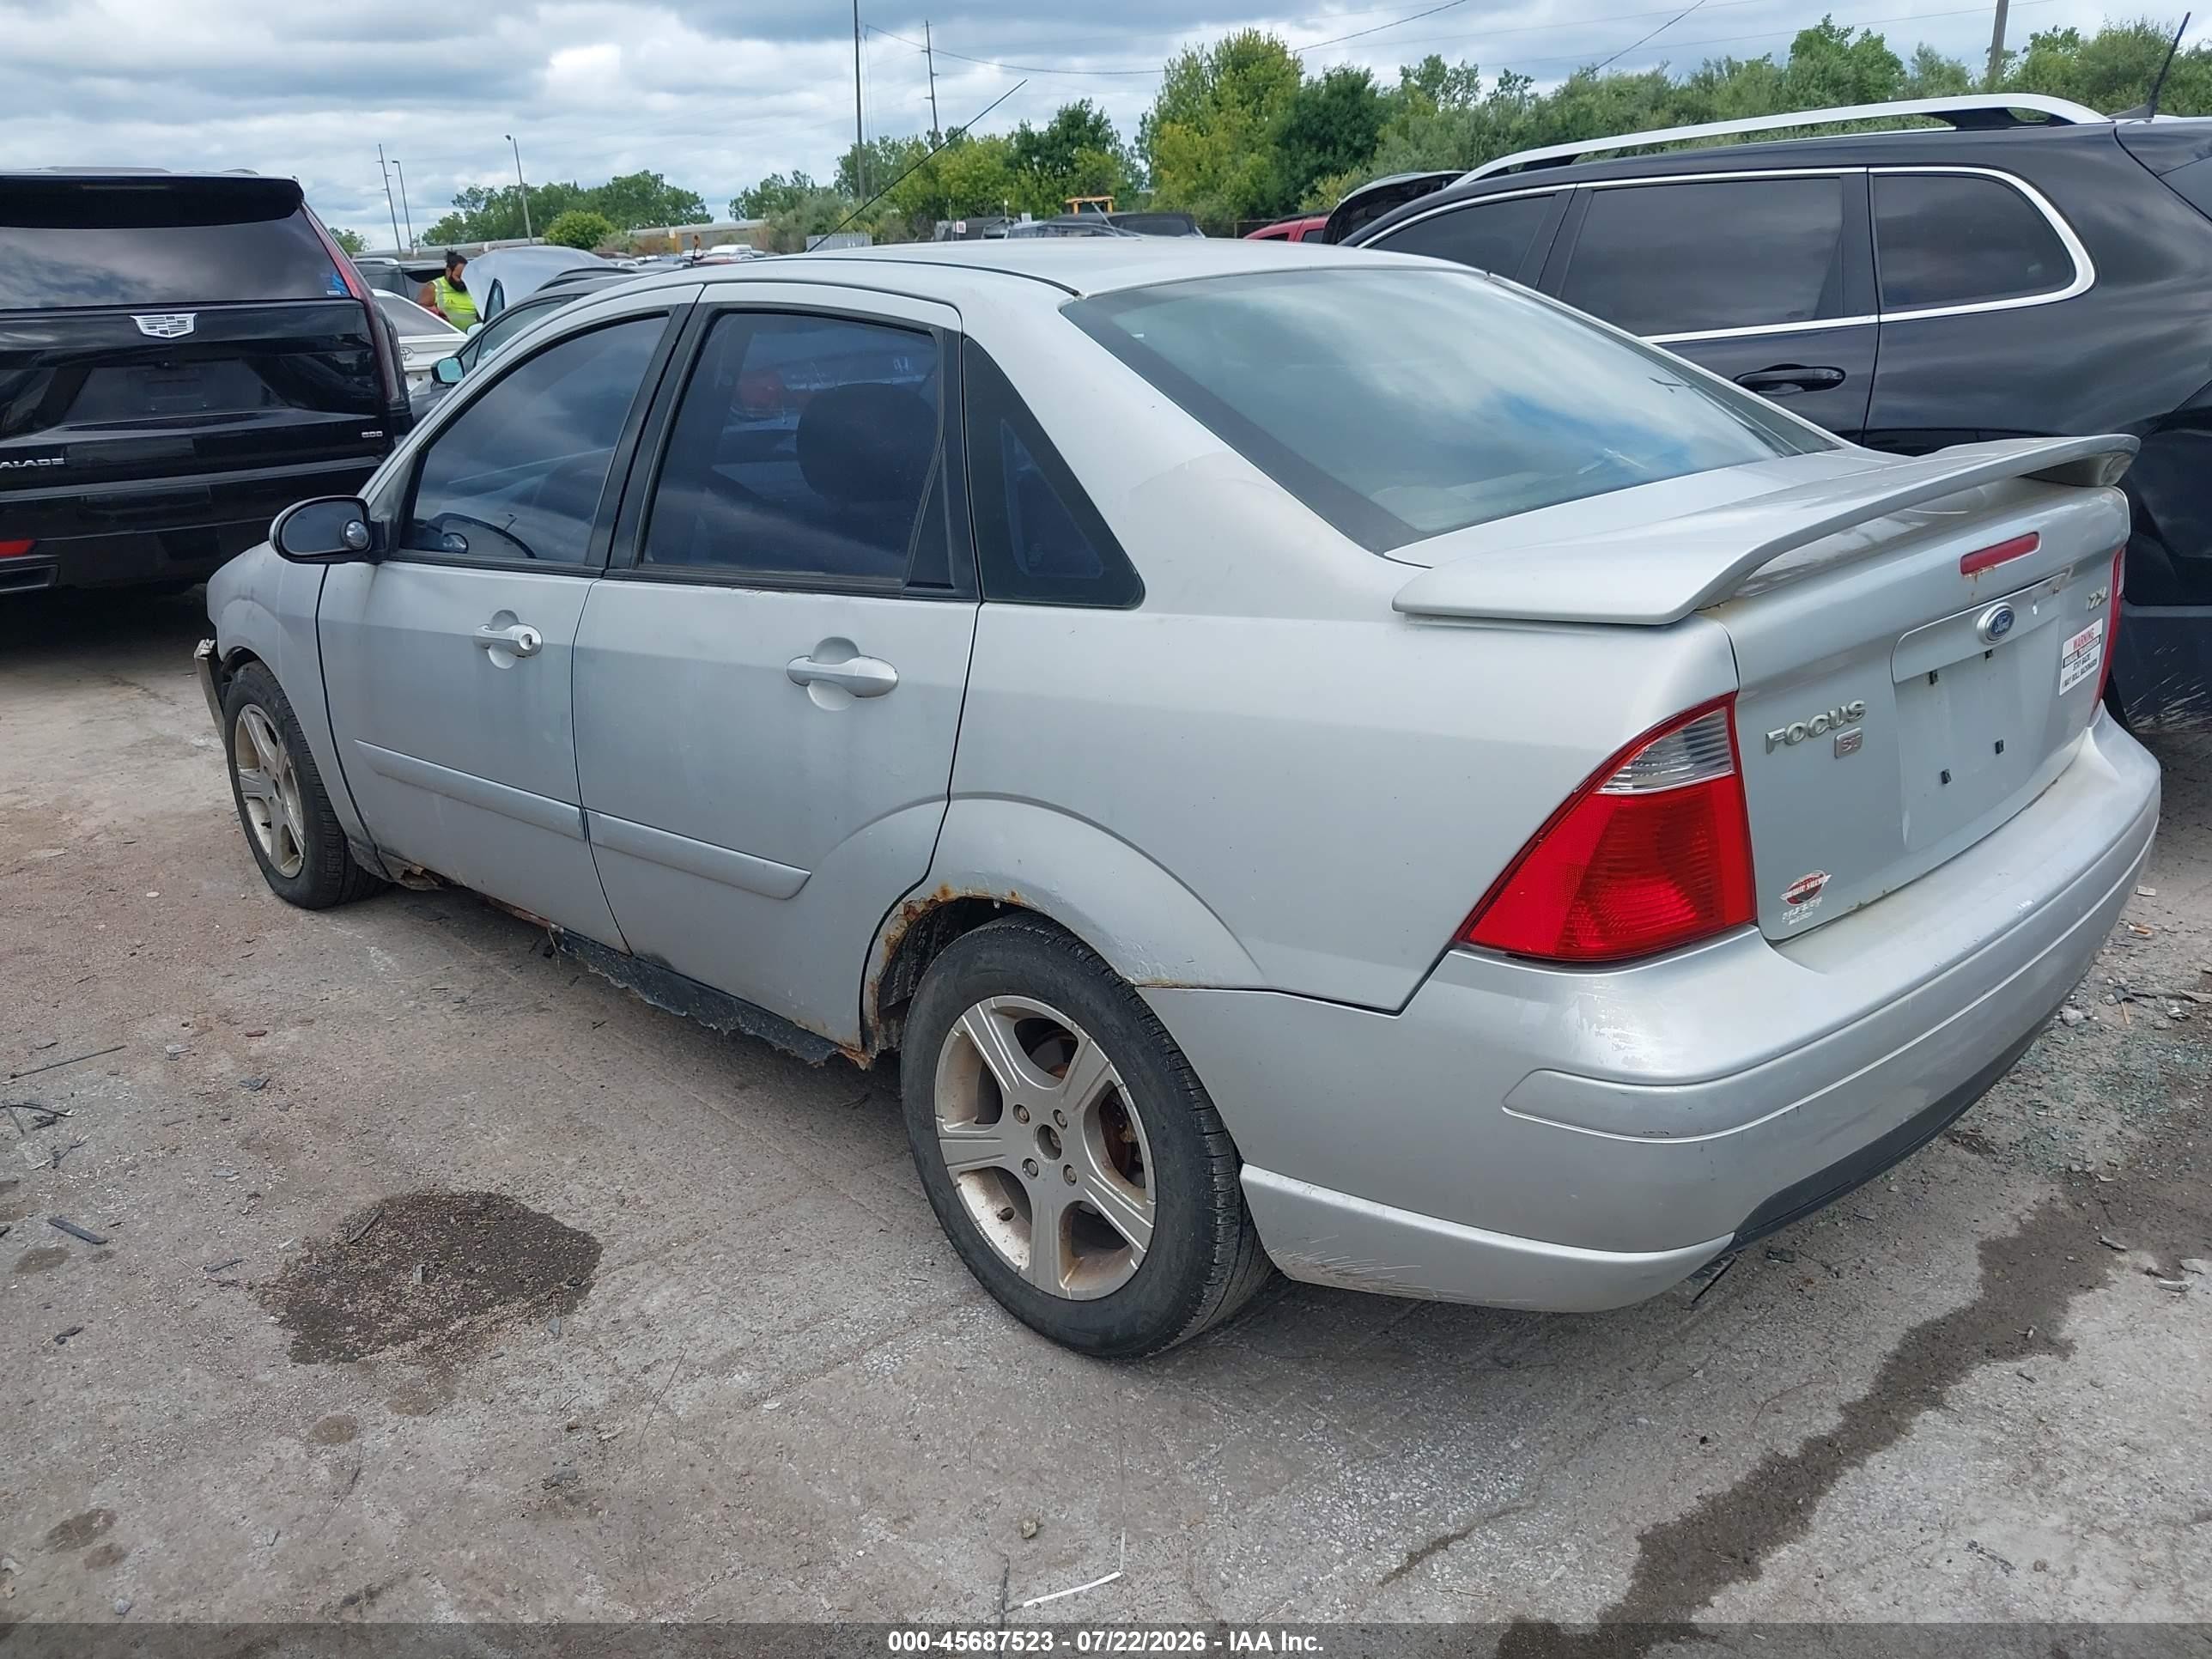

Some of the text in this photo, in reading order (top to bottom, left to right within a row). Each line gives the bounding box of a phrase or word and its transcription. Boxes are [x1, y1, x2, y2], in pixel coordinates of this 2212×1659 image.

[2073, 627, 2095, 651] WARNING
[2073, 659, 2081, 672] STAY
[1765, 700, 1866, 755] FOCUS
